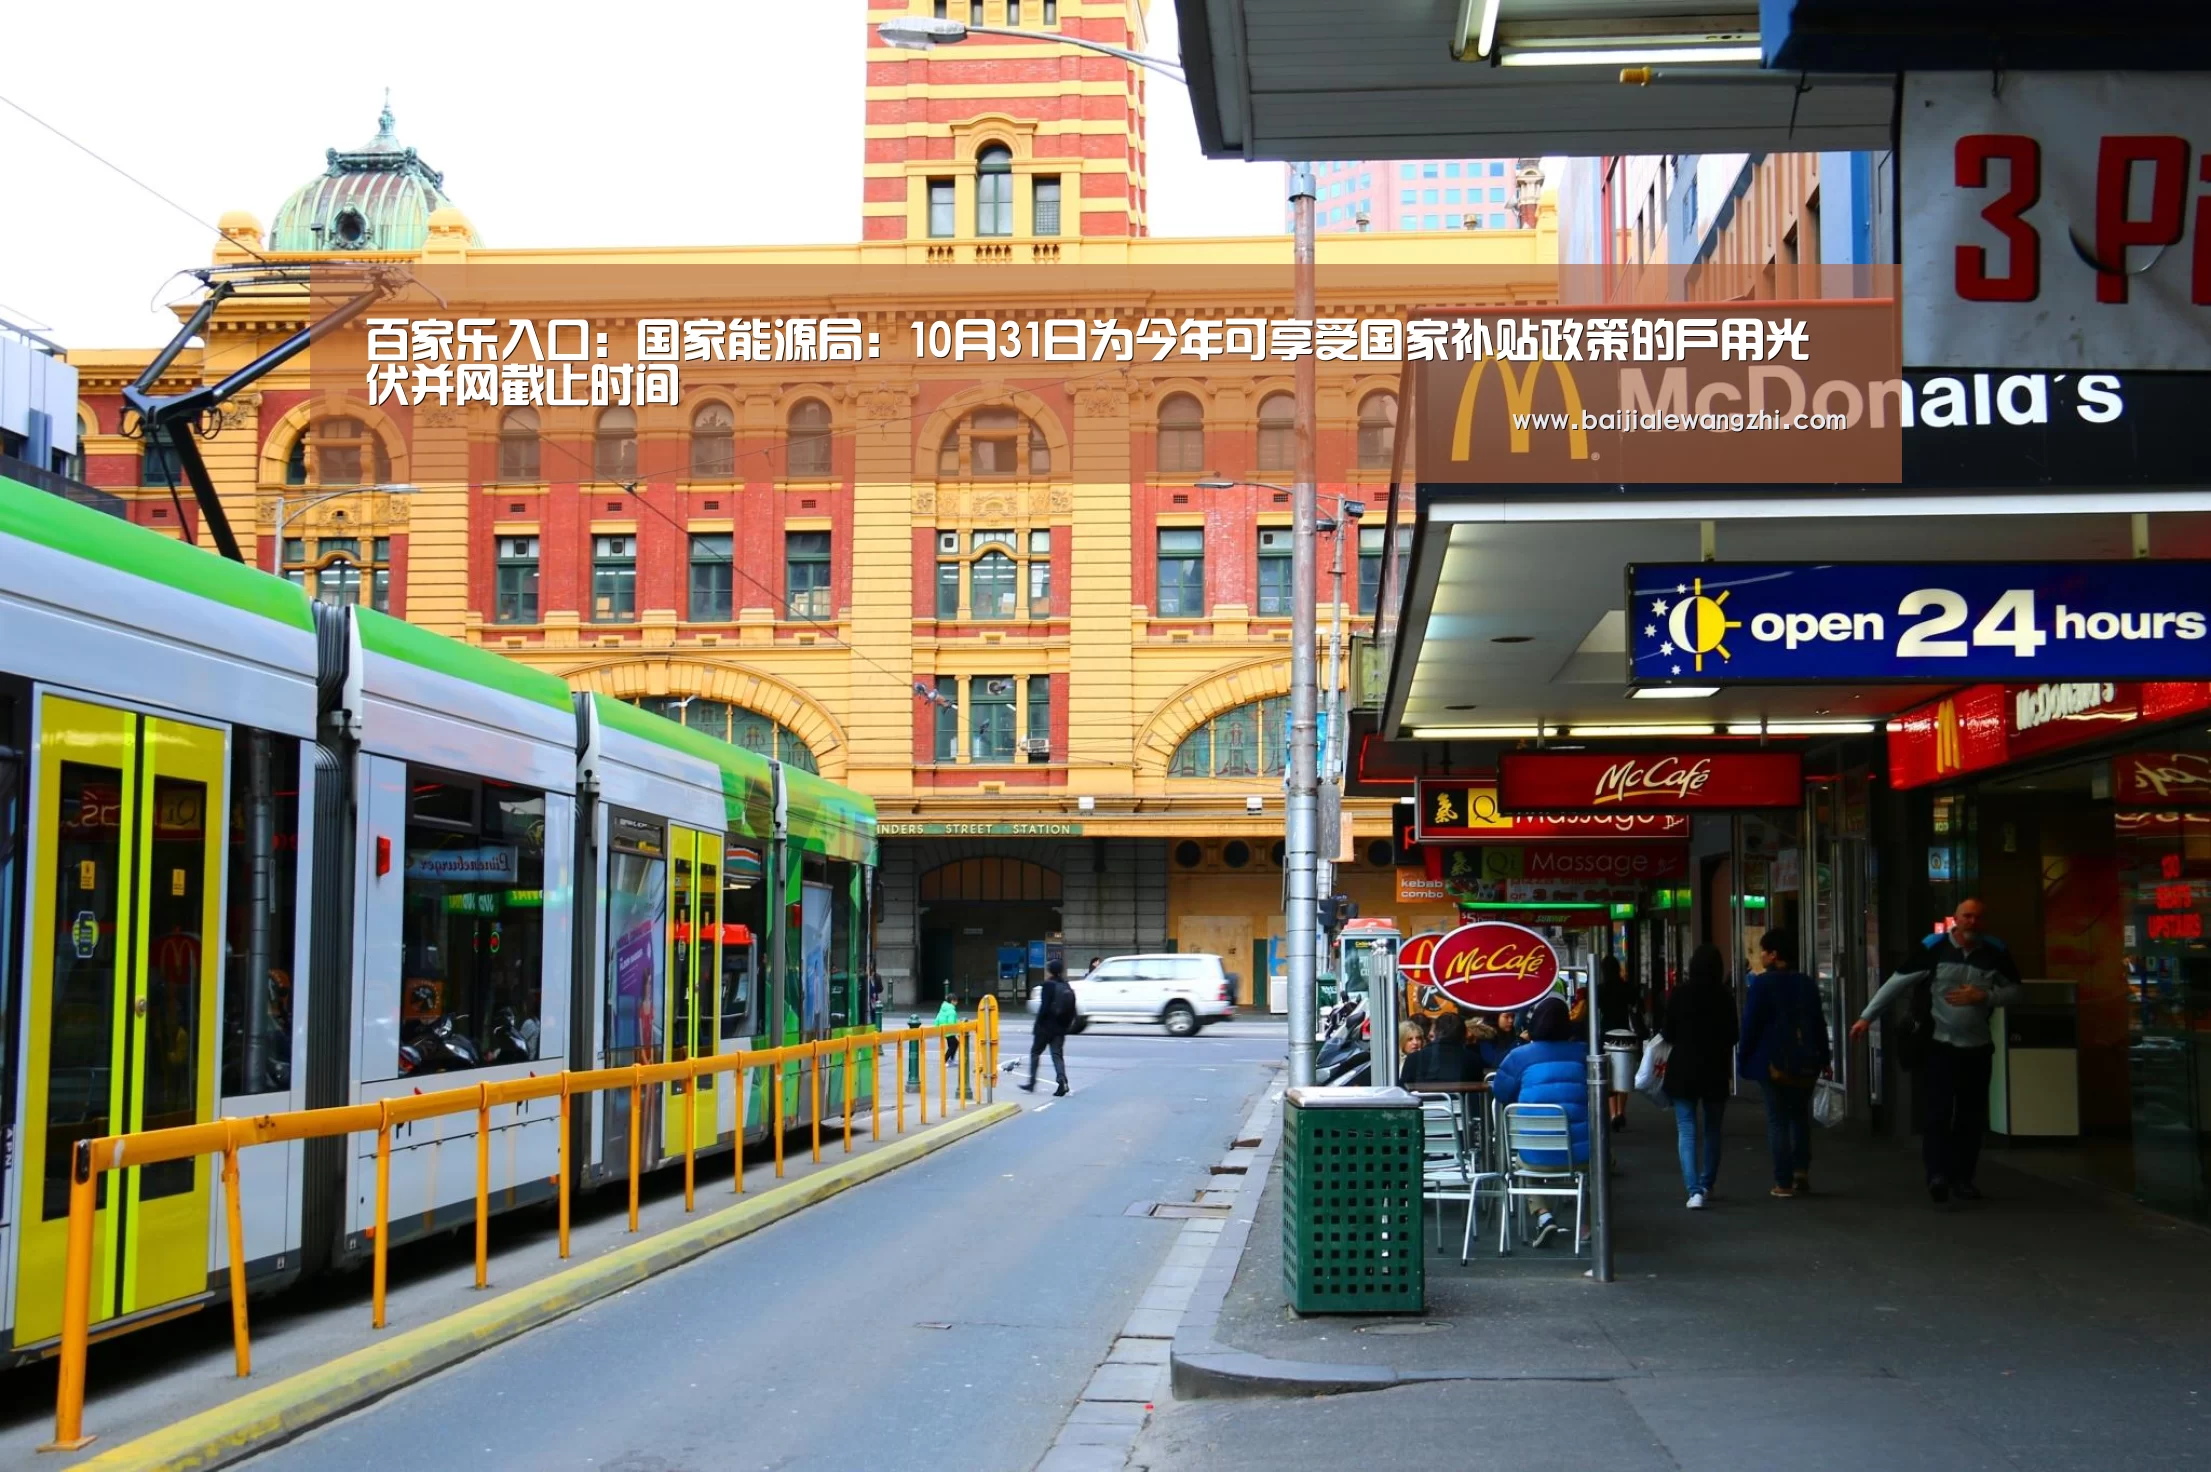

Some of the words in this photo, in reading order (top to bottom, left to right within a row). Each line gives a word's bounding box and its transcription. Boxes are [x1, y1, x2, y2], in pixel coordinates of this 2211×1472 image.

[1955, 134, 2041, 302] 3
[1751, 612, 1884, 650] open
[1896, 588, 2047, 658] 24
[2055, 604, 2208, 640] hours
[1593, 756, 1711, 801] McCafé
[945, 823, 992, 835] STREET
[1012, 823, 1071, 835] STATION
[1531, 851, 1649, 878] Massage
[1401, 878, 1443, 889] kebab
[1401, 889, 1444, 899] combo
[1444, 943, 1547, 984] McCafé
